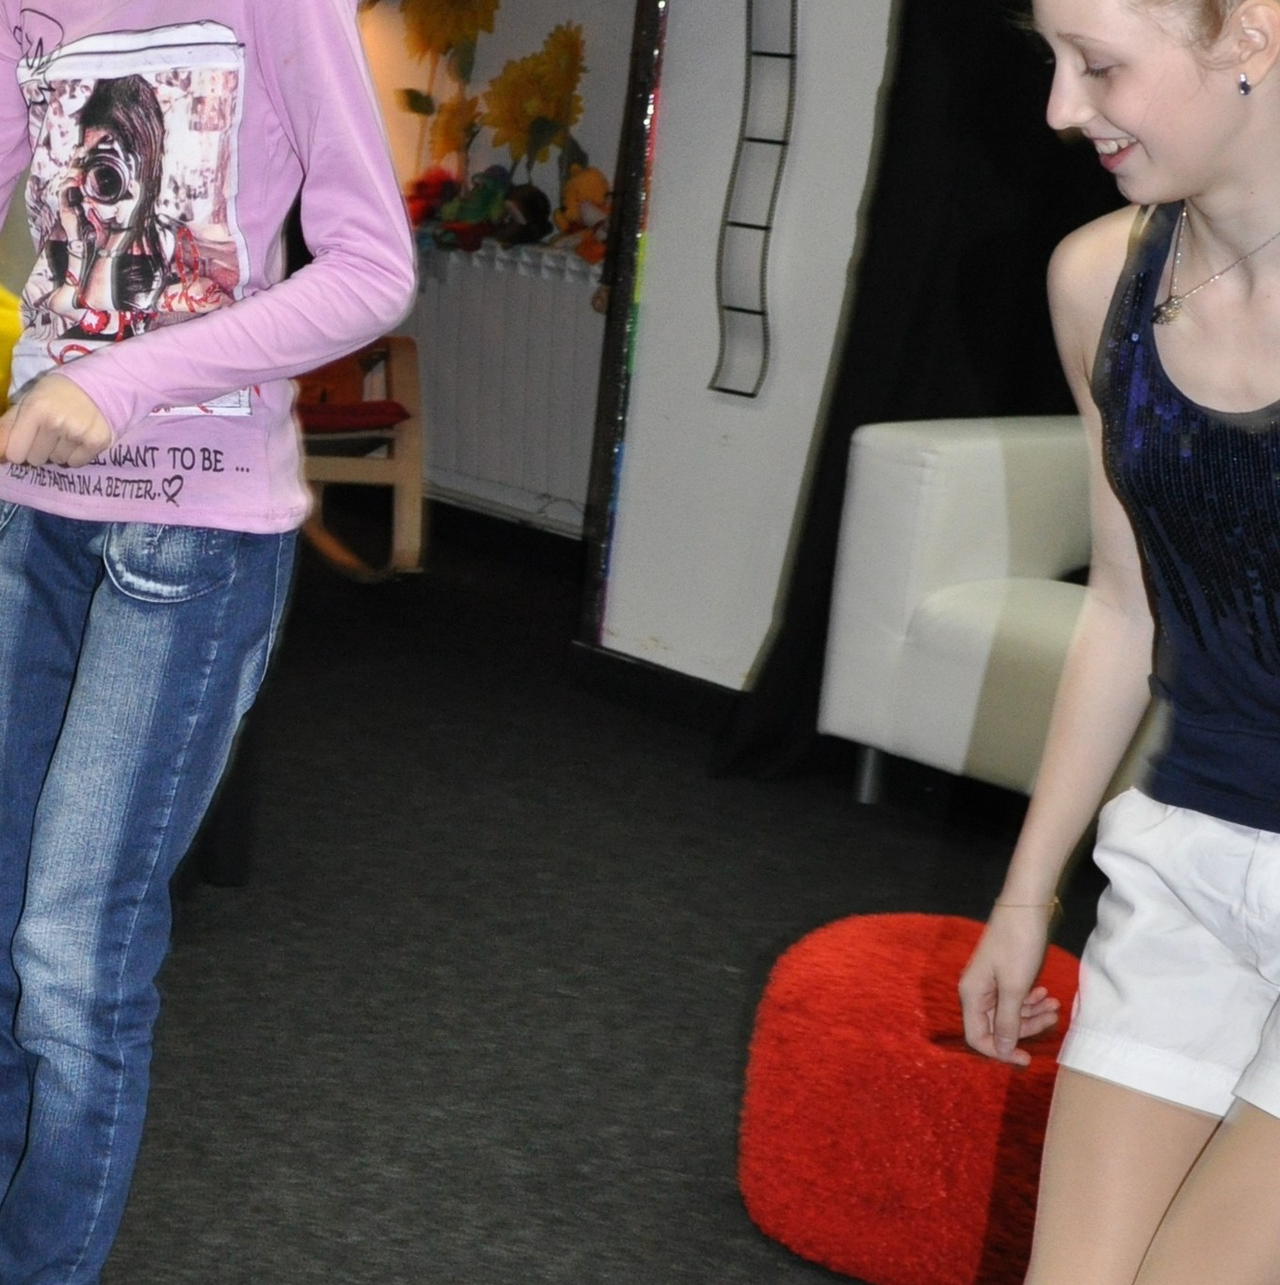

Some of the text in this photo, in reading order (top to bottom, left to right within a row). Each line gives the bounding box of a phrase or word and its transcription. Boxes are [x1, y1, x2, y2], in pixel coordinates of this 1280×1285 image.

[109, 444, 159, 468] WANT
[168, 446, 195, 471] TO
[200, 447, 225, 473] BE
[29, 465, 47, 486] THE
[47, 469, 76, 494] FAITH
[77, 475, 91, 496] IN
[92, 476, 103, 496] A
